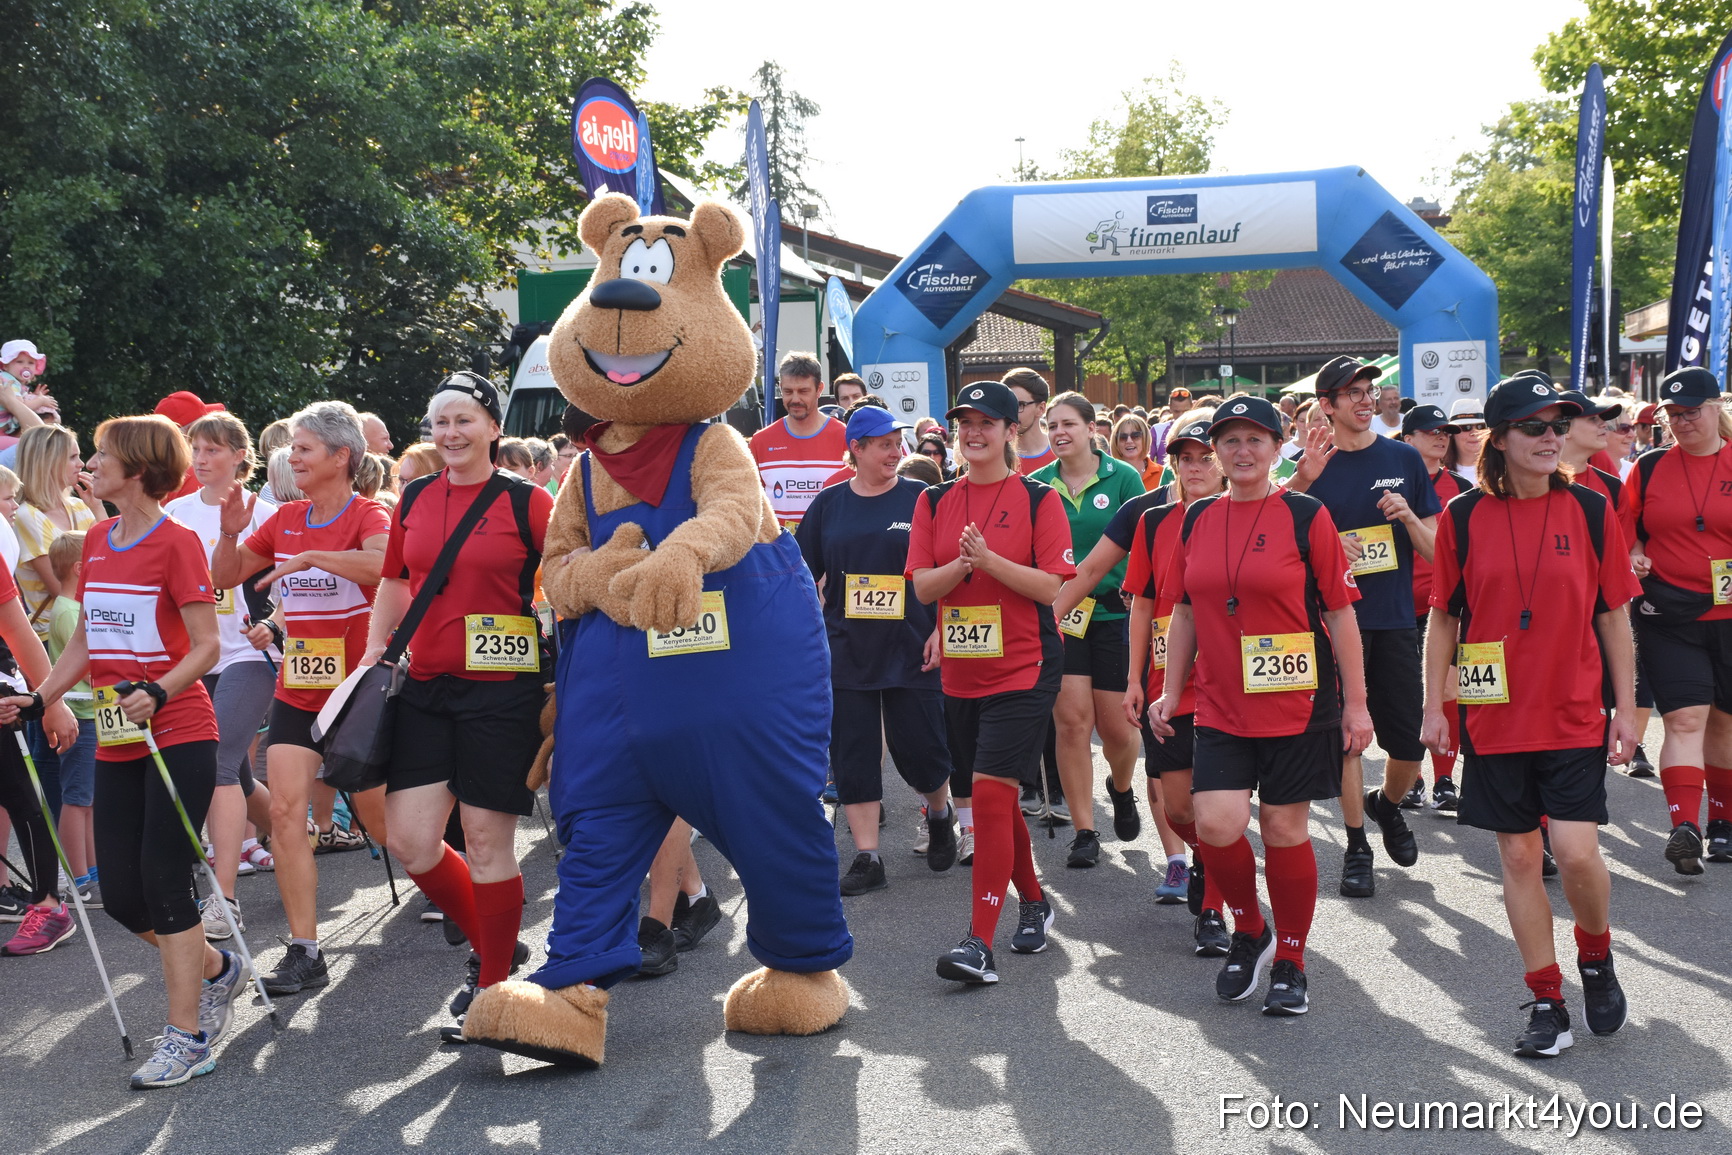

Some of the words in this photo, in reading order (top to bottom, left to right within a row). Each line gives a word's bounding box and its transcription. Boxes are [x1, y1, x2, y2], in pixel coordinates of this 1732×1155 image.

[1157, 203, 1196, 217] Fischer
[1129, 222, 1242, 247] firmenlauf
[1129, 247, 1175, 256] neumarkt
[1361, 253, 1379, 264] und
[1379, 251, 1398, 261] das
[918, 272, 978, 287] Fischer
[923, 285, 973, 293] AUTOMOBILE
[999, 511, 1009, 524] 7
[1256, 534, 1266, 547] 5
[1554, 534, 1571, 551] 11
[290, 577, 338, 591] Petry
[853, 590, 898, 607] 1427
[91, 609, 135, 627] Petry
[656, 613, 717, 639] 340
[663, 638, 693, 646] Kenyeres
[947, 624, 993, 644] 2347
[474, 634, 530, 656] 2359
[290, 656, 337, 675] 1826
[1252, 653, 1309, 677] 2366
[98, 706, 129, 730] 181
